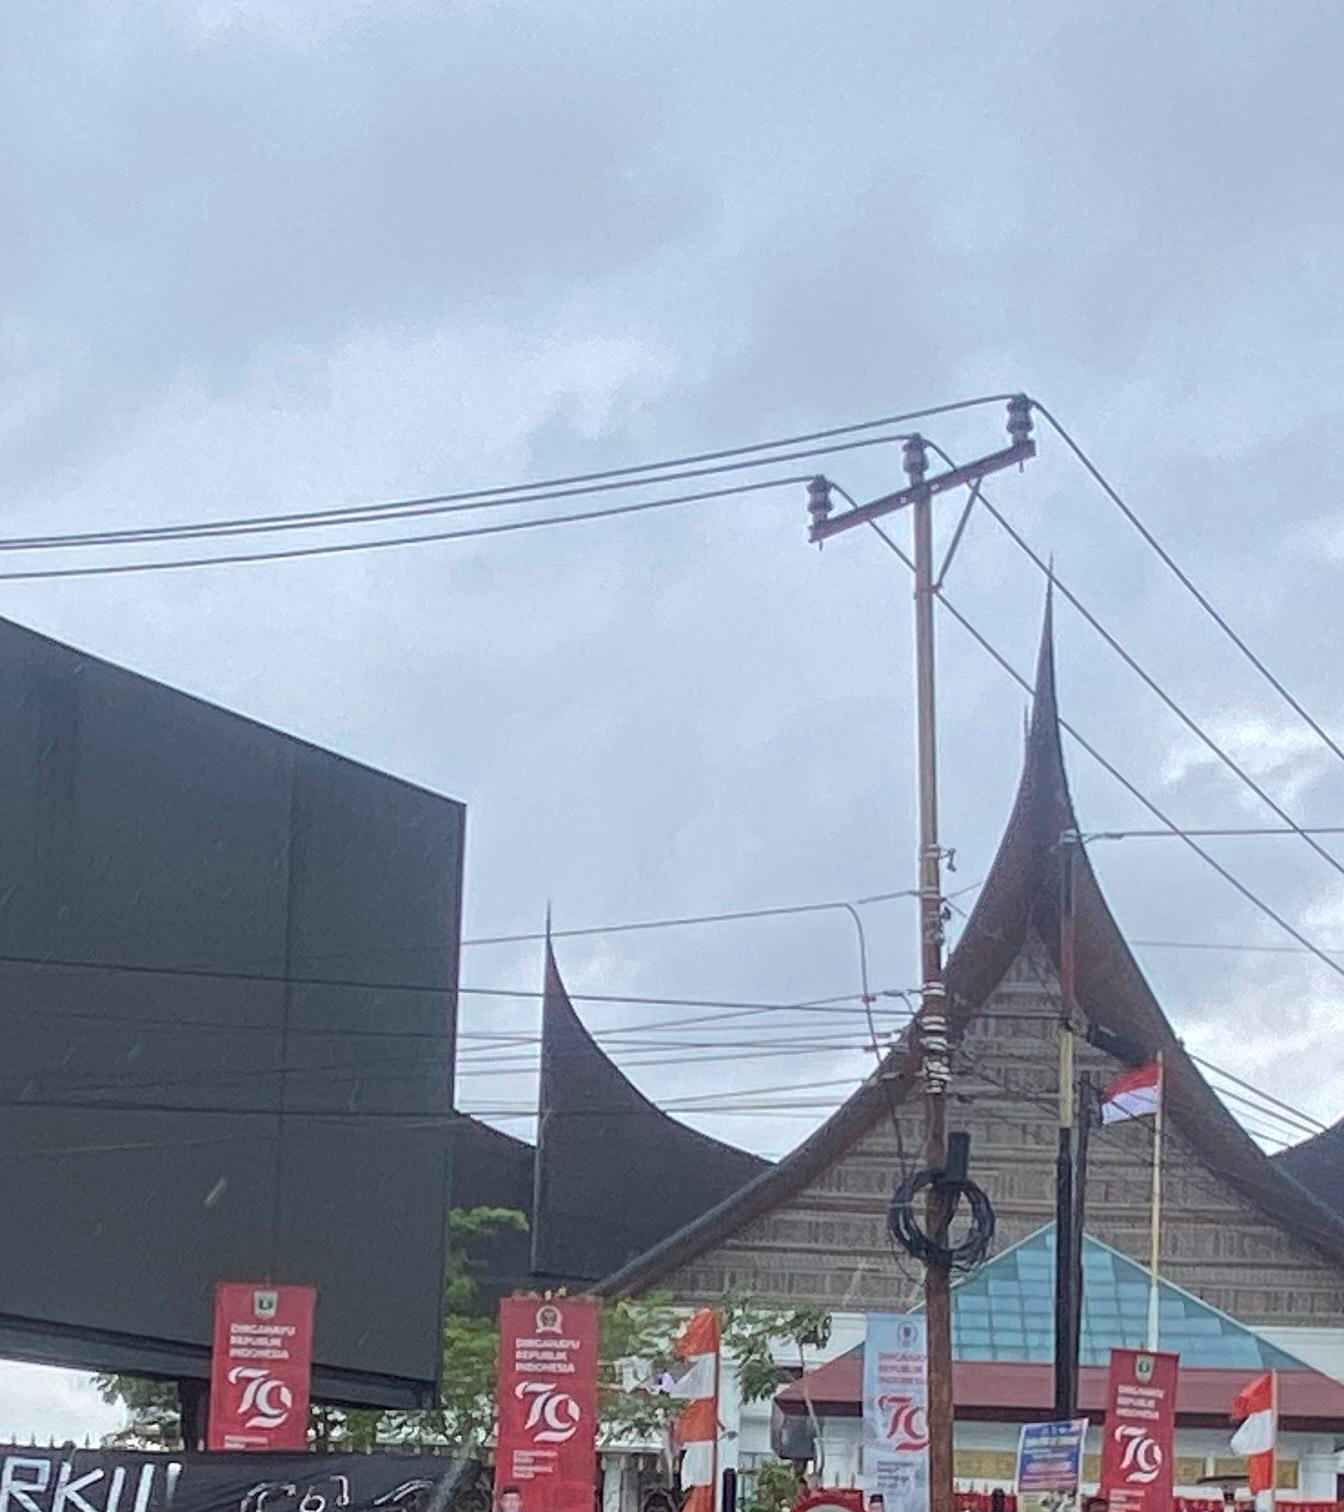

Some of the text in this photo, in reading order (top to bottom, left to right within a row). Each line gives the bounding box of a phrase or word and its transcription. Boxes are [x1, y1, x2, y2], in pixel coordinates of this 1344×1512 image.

[228, 1366, 292, 1428] 79
[514, 1381, 580, 1442] 79
[1114, 1424, 1162, 1483] 79
